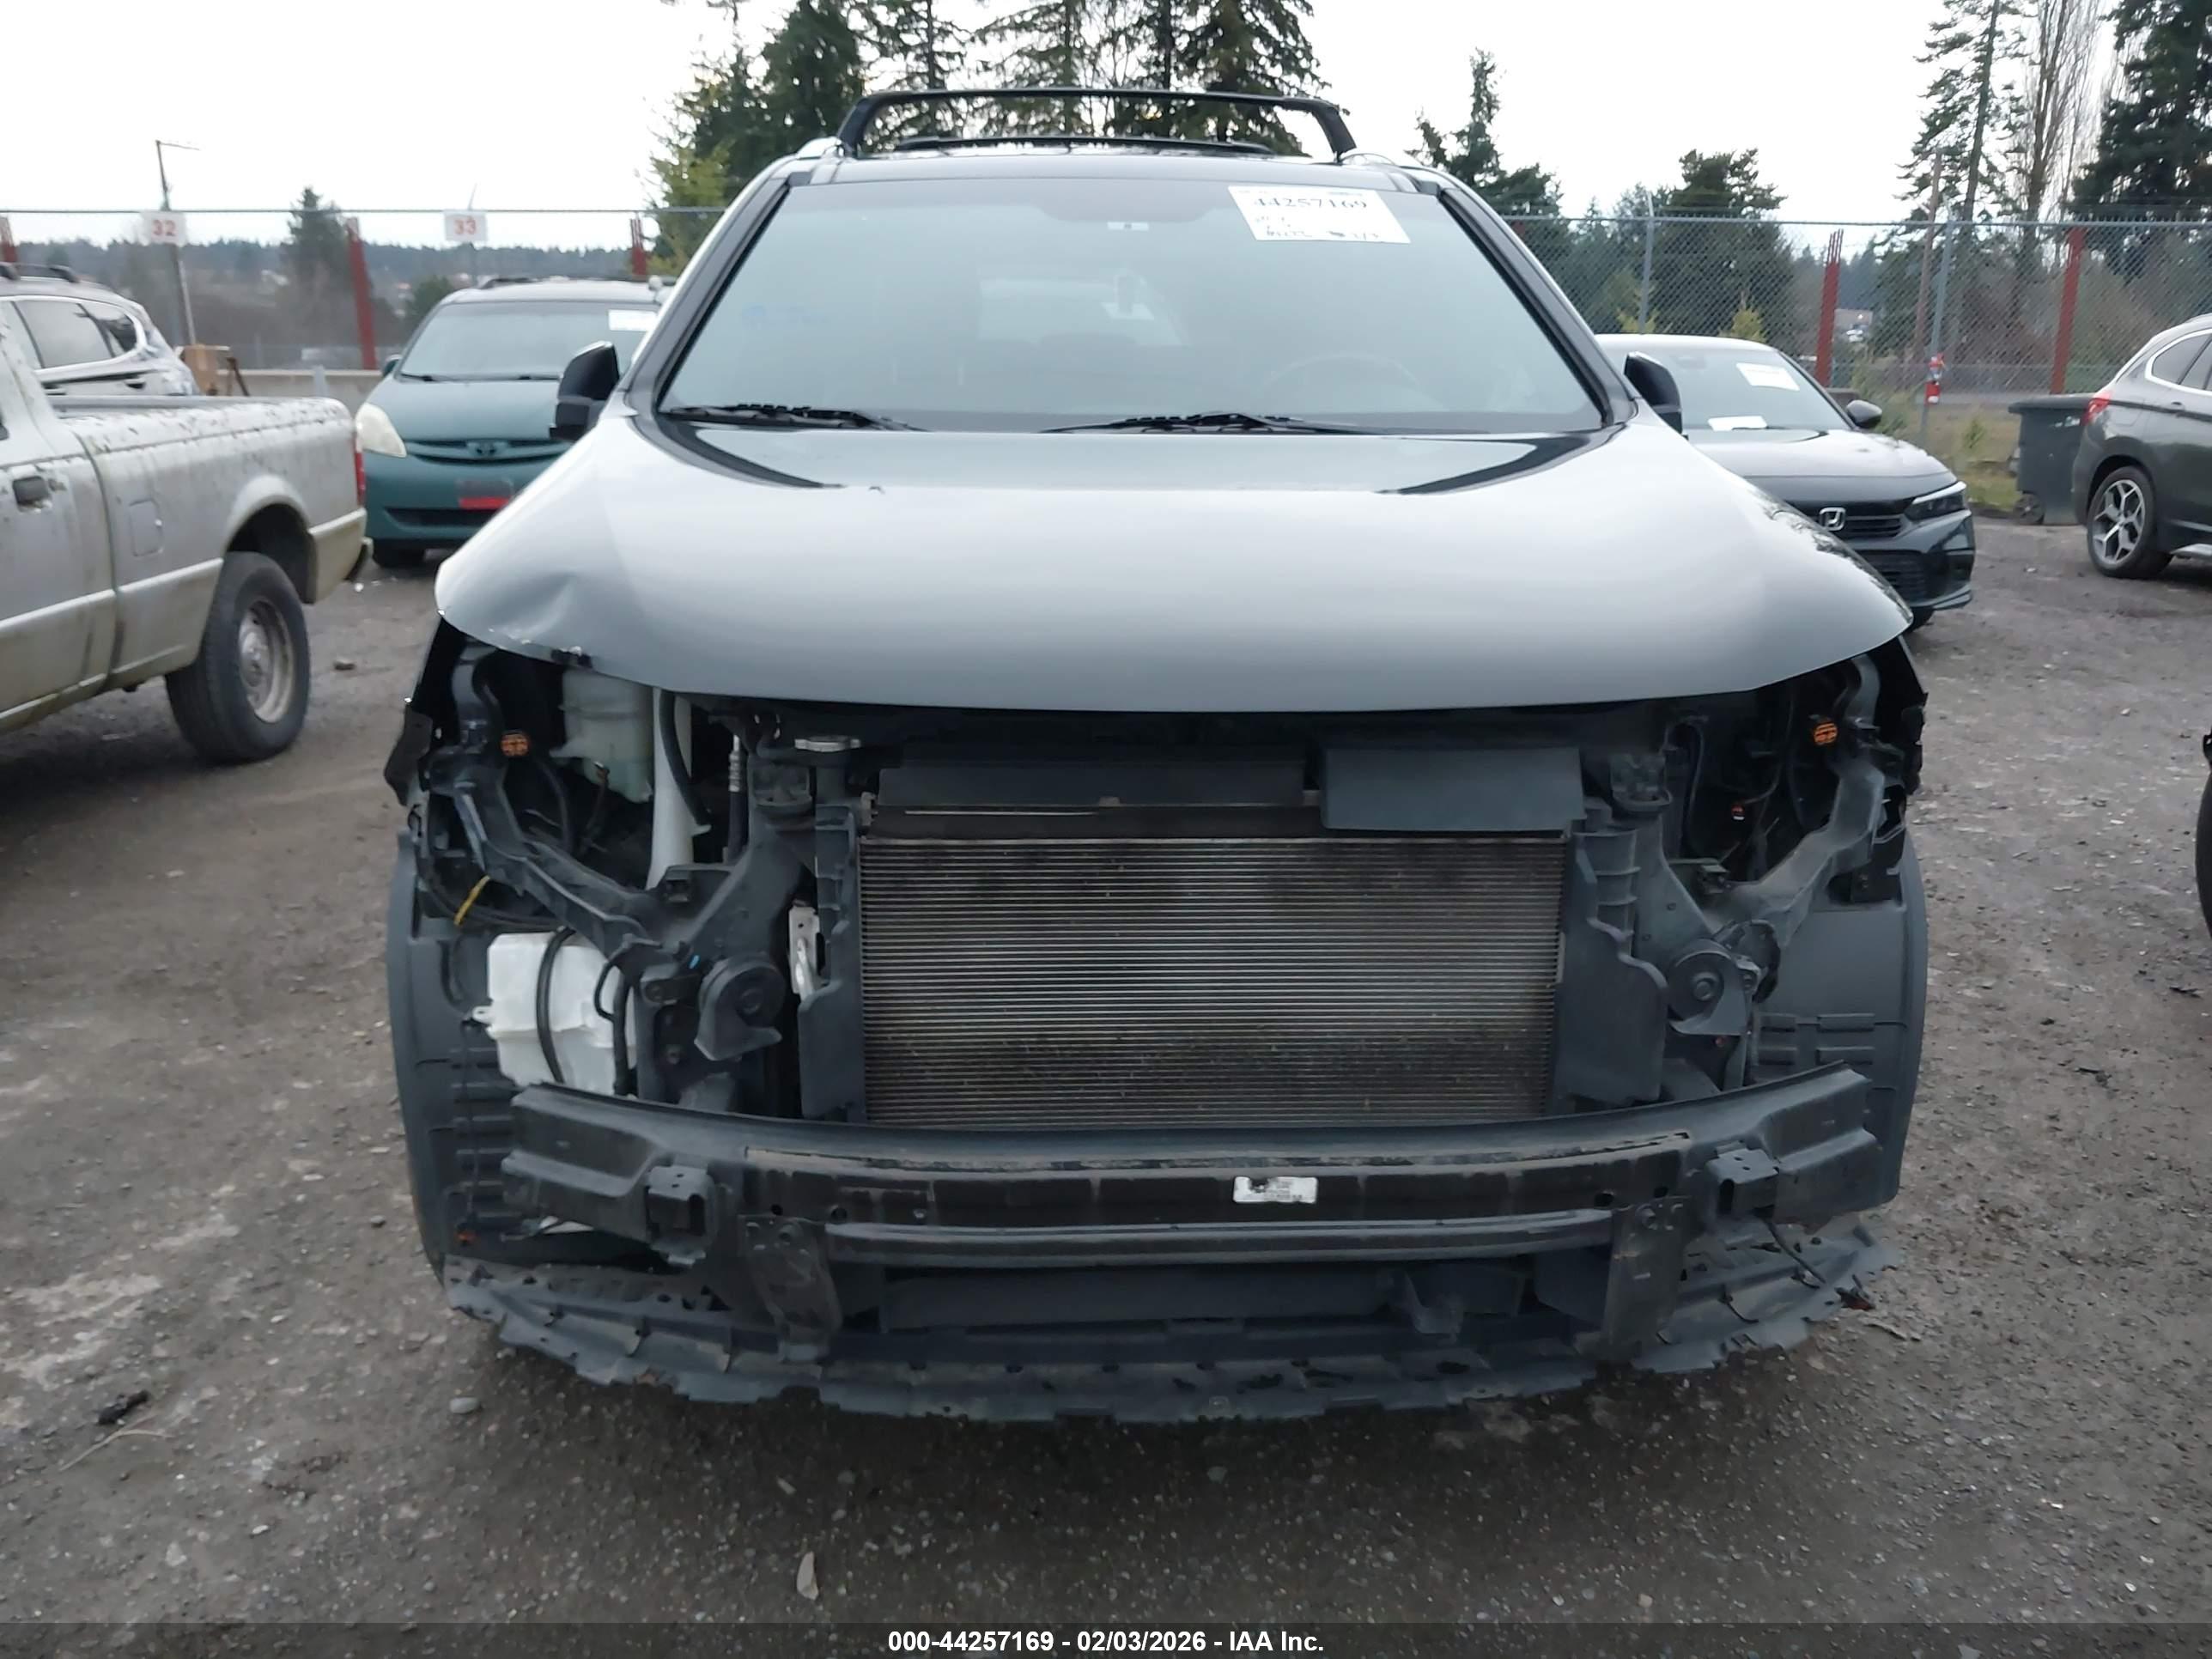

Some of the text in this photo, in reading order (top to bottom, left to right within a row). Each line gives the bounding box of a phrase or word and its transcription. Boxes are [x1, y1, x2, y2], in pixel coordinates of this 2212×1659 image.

[1255, 198, 1367, 209] 44257169
[153, 219, 176, 237] 32
[454, 218, 477, 235] 33
